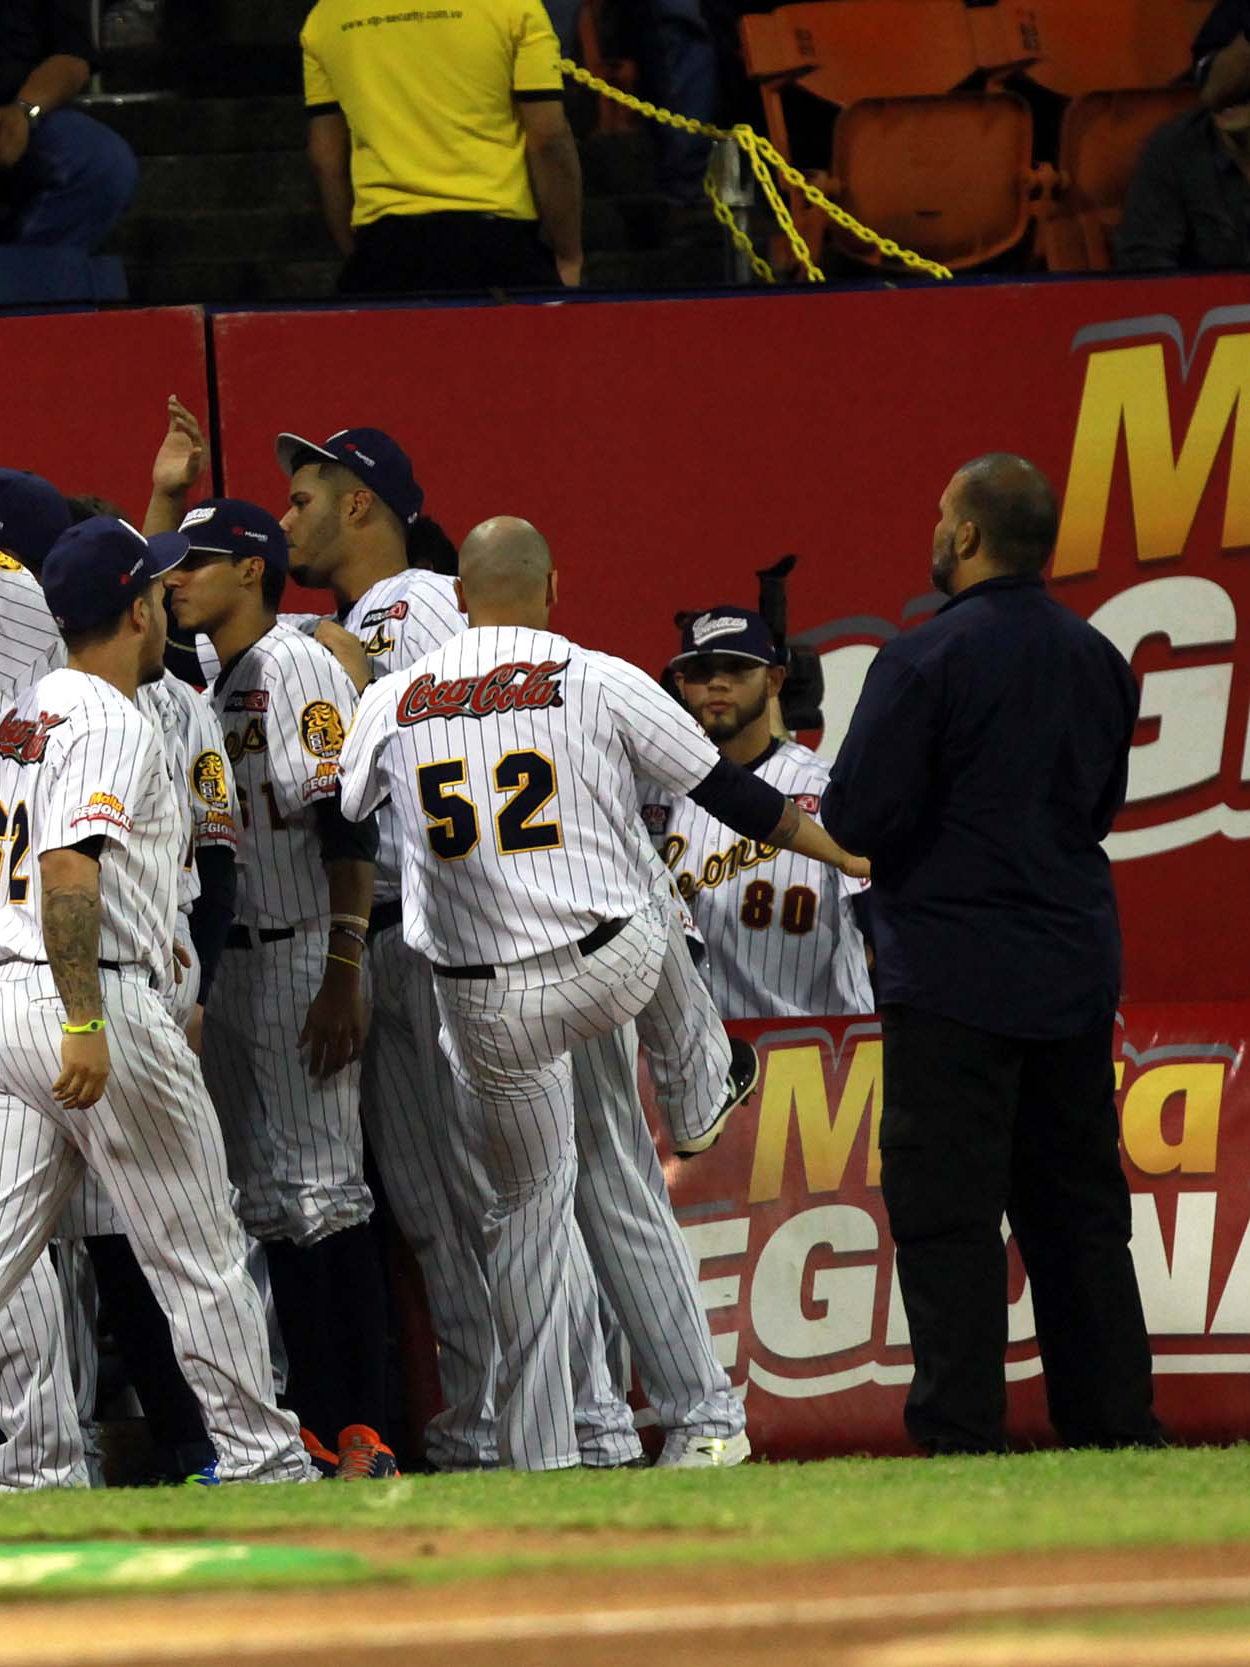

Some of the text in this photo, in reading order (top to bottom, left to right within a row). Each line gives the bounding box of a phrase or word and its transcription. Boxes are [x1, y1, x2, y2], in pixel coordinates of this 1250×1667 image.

[397, 659, 571, 727] Coca-Cola
[72, 802, 134, 832] REGIONAL
[415, 748, 563, 862] 52
[665, 833, 781, 901] Leone
[741, 880, 816, 935] 80
